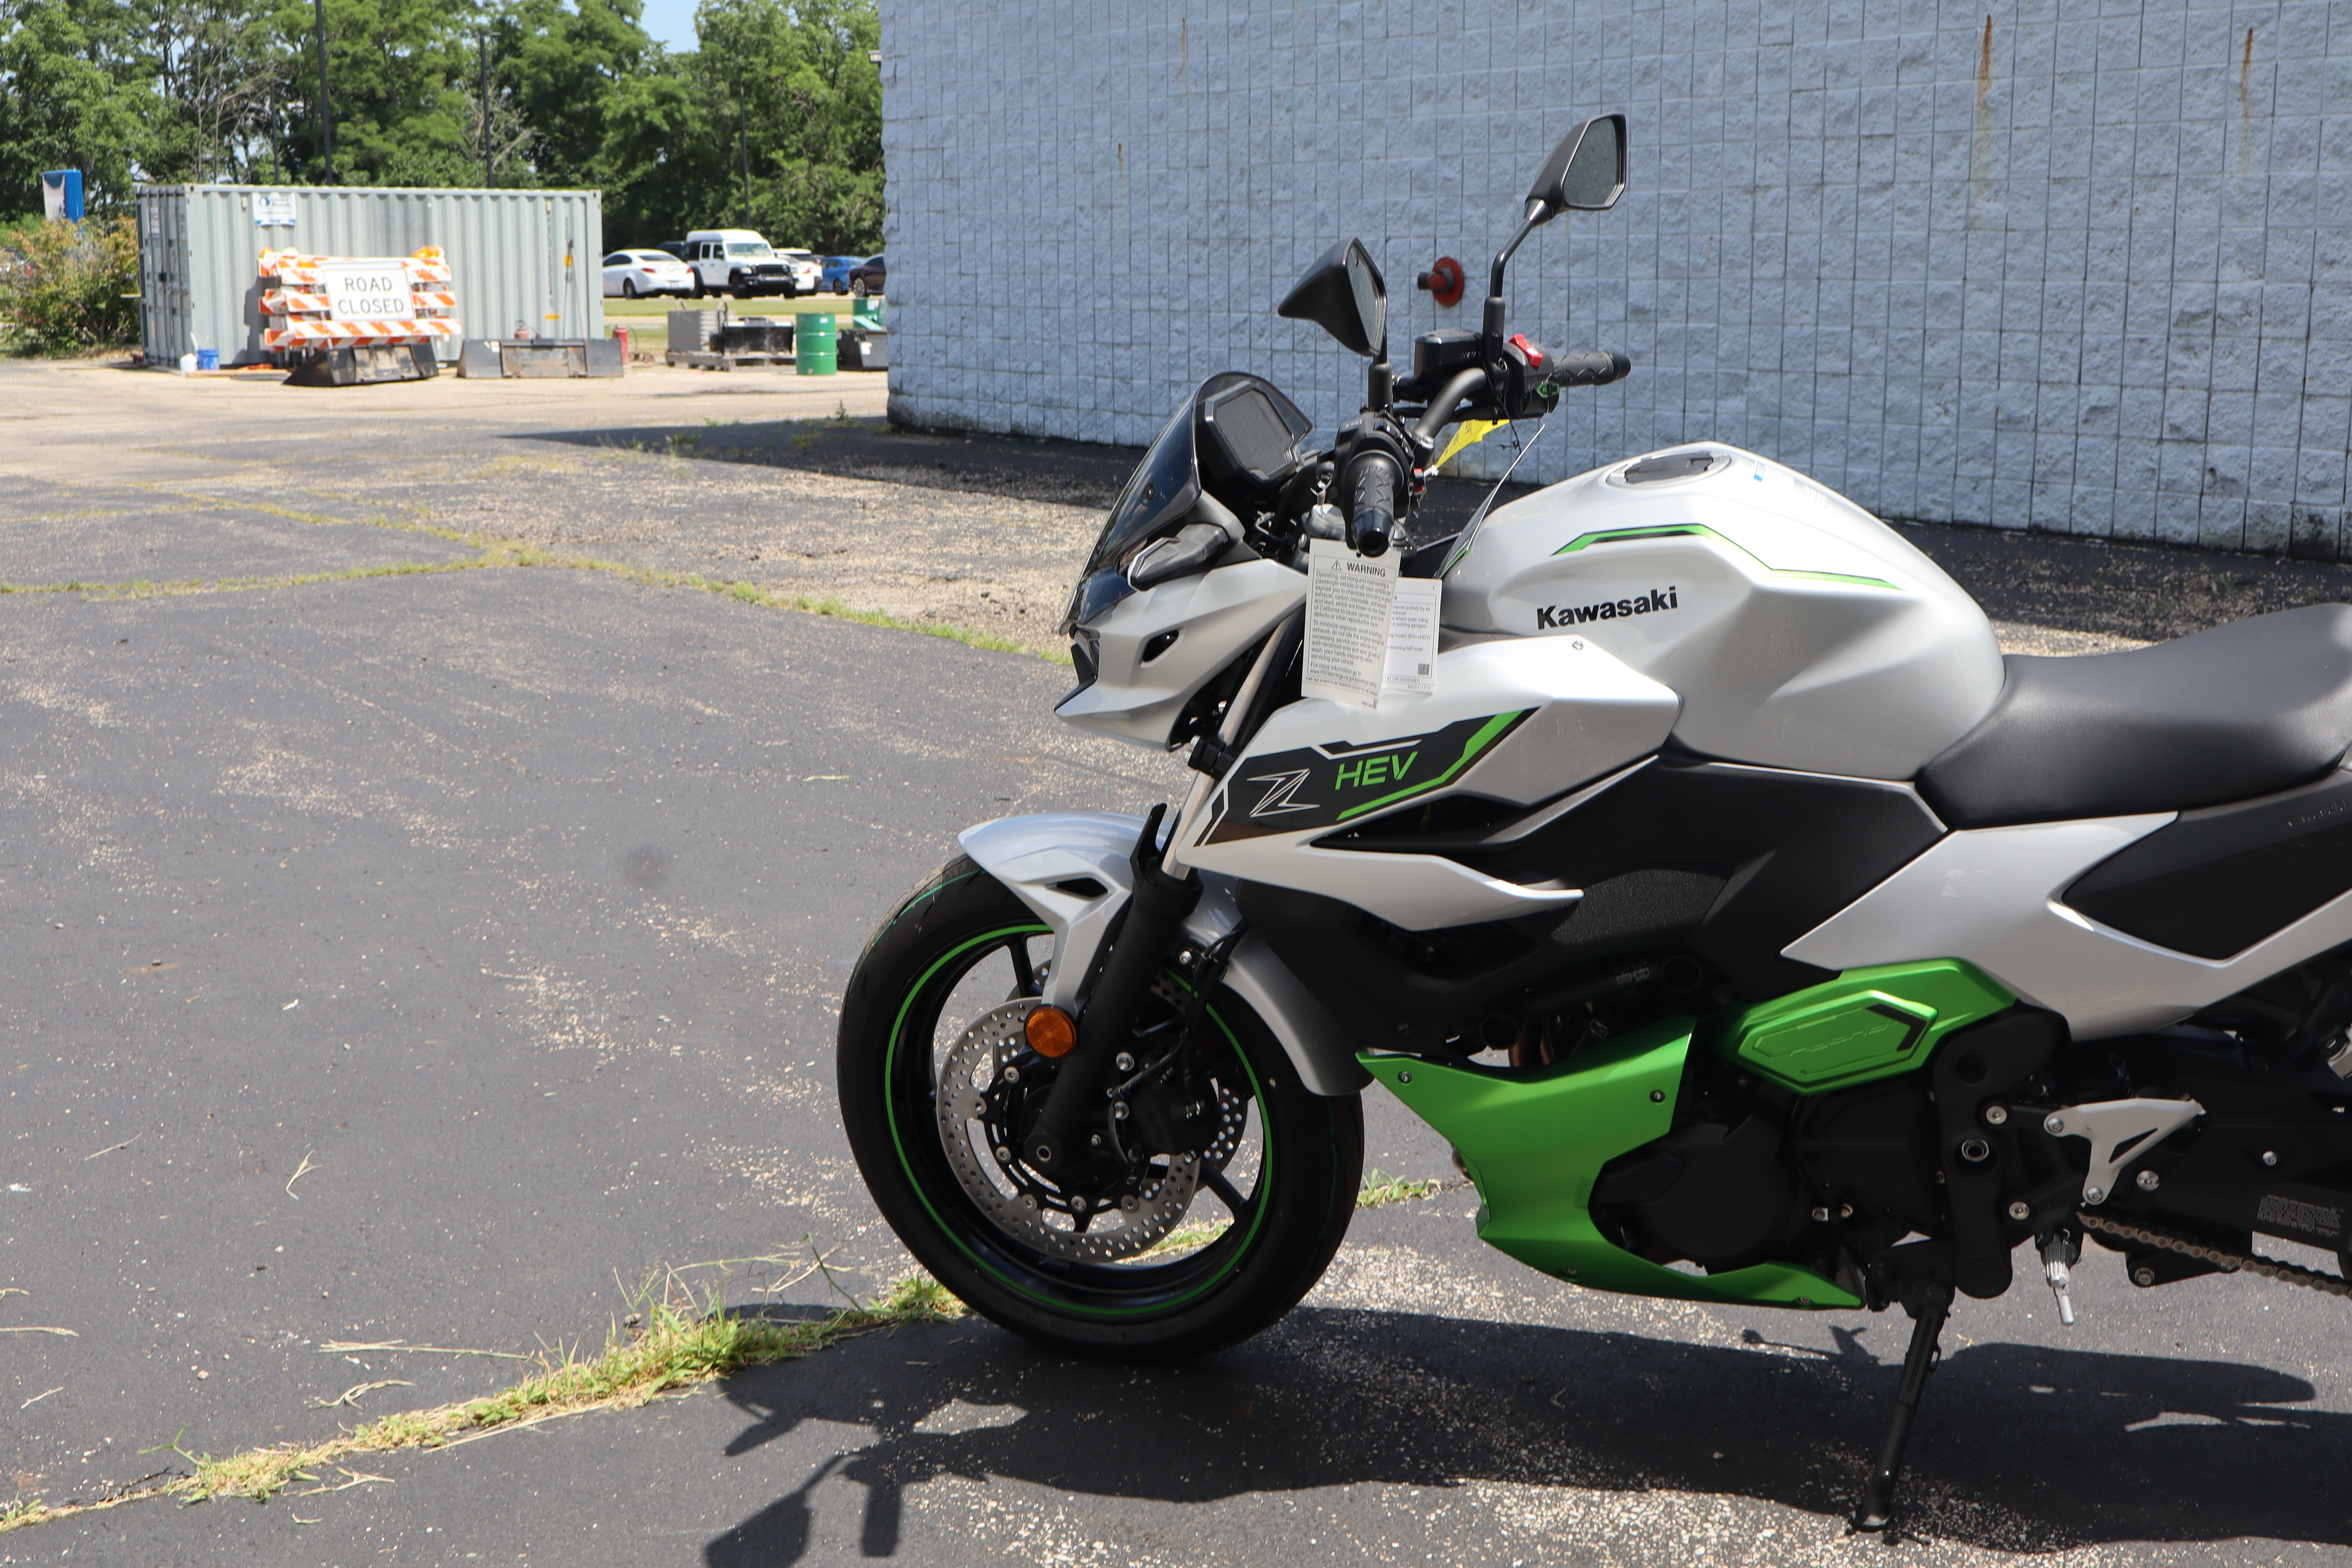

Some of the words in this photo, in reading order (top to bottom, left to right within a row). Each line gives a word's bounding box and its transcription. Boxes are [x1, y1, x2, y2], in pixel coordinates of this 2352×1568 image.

[345, 277, 392, 292] ROAD
[338, 298, 404, 314] CLOSED
[1347, 562, 1385, 577] WARNING
[1316, 570, 1339, 580] Operating,
[1340, 575, 1358, 583] servicing
[1316, 578, 1339, 586] passenger
[1315, 591, 1334, 599] exhaust,
[1350, 596, 1369, 605] monoxide,
[1319, 605, 1340, 613] California
[1537, 586, 1678, 630] Kawasaki
[1339, 625, 1357, 633] exposure,
[1312, 634, 1335, 643] necessary,
[1312, 641, 1341, 650] well-ventilated
[1311, 653, 1330, 662] servicing
[1331, 665, 1352, 673] information
[1335, 751, 1419, 790] HEV
